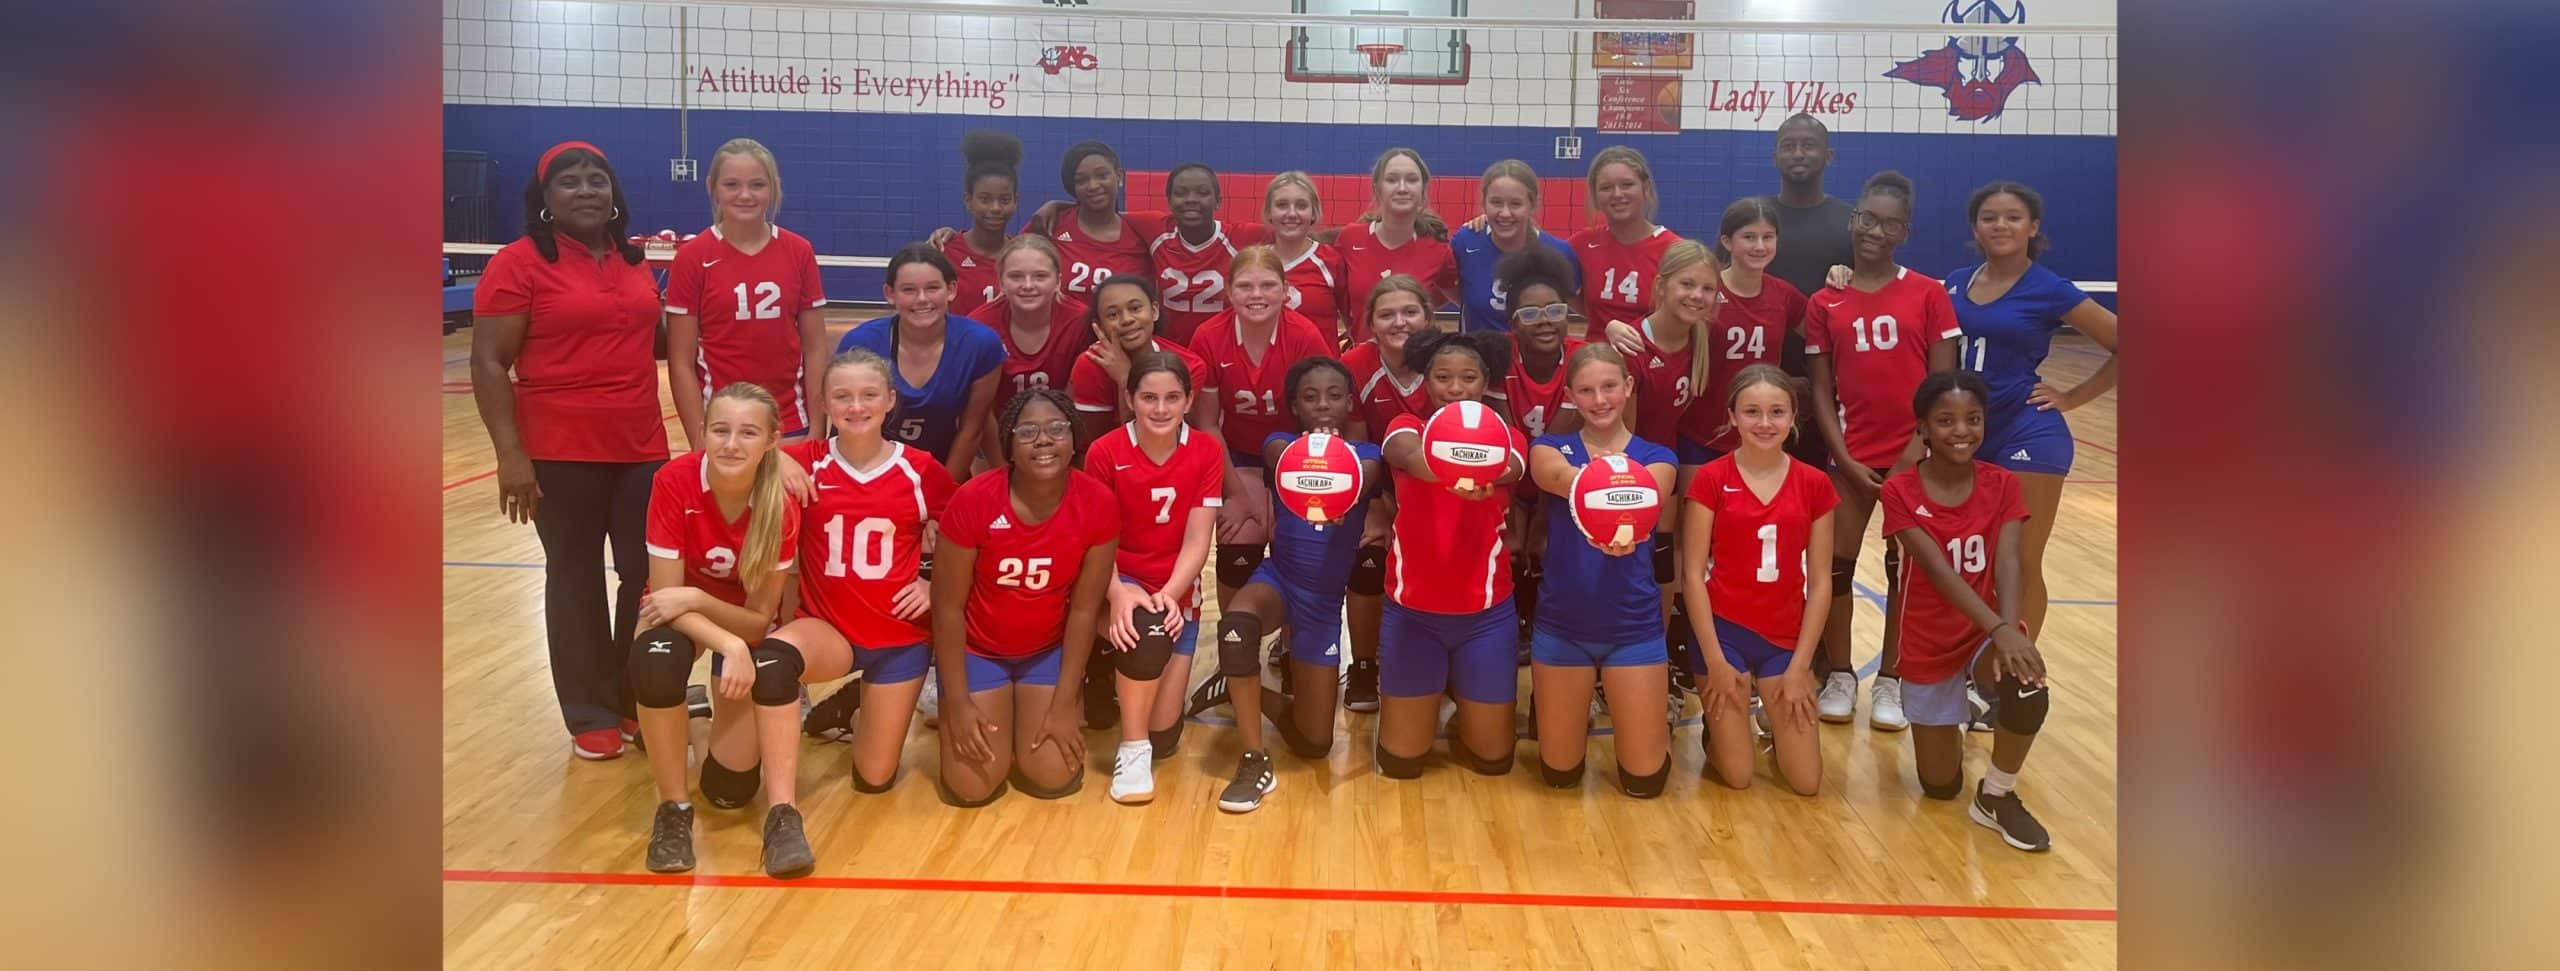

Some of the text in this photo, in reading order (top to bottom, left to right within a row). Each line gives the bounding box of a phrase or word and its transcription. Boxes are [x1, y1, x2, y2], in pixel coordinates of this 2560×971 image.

[686, 66, 1020, 109] "Attitude is Everything"
[1708, 80, 1858, 122] Lady Vikes
[733, 281, 782, 321] 12
[1160, 267, 1225, 313] 22
[1600, 267, 1639, 304] 14
[1726, 325, 1766, 359] 24
[1852, 314, 1898, 352] 10
[1958, 335, 1986, 372] 11
[1235, 389, 1279, 416] 21
[1522, 404, 1546, 438] 4
[899, 418, 925, 441] 5
[1150, 487, 1177, 524] 7
[823, 514, 897, 580] 10
[1756, 524, 1780, 583] 1
[1946, 534, 1987, 574] 19
[996, 556, 1053, 591] 25
